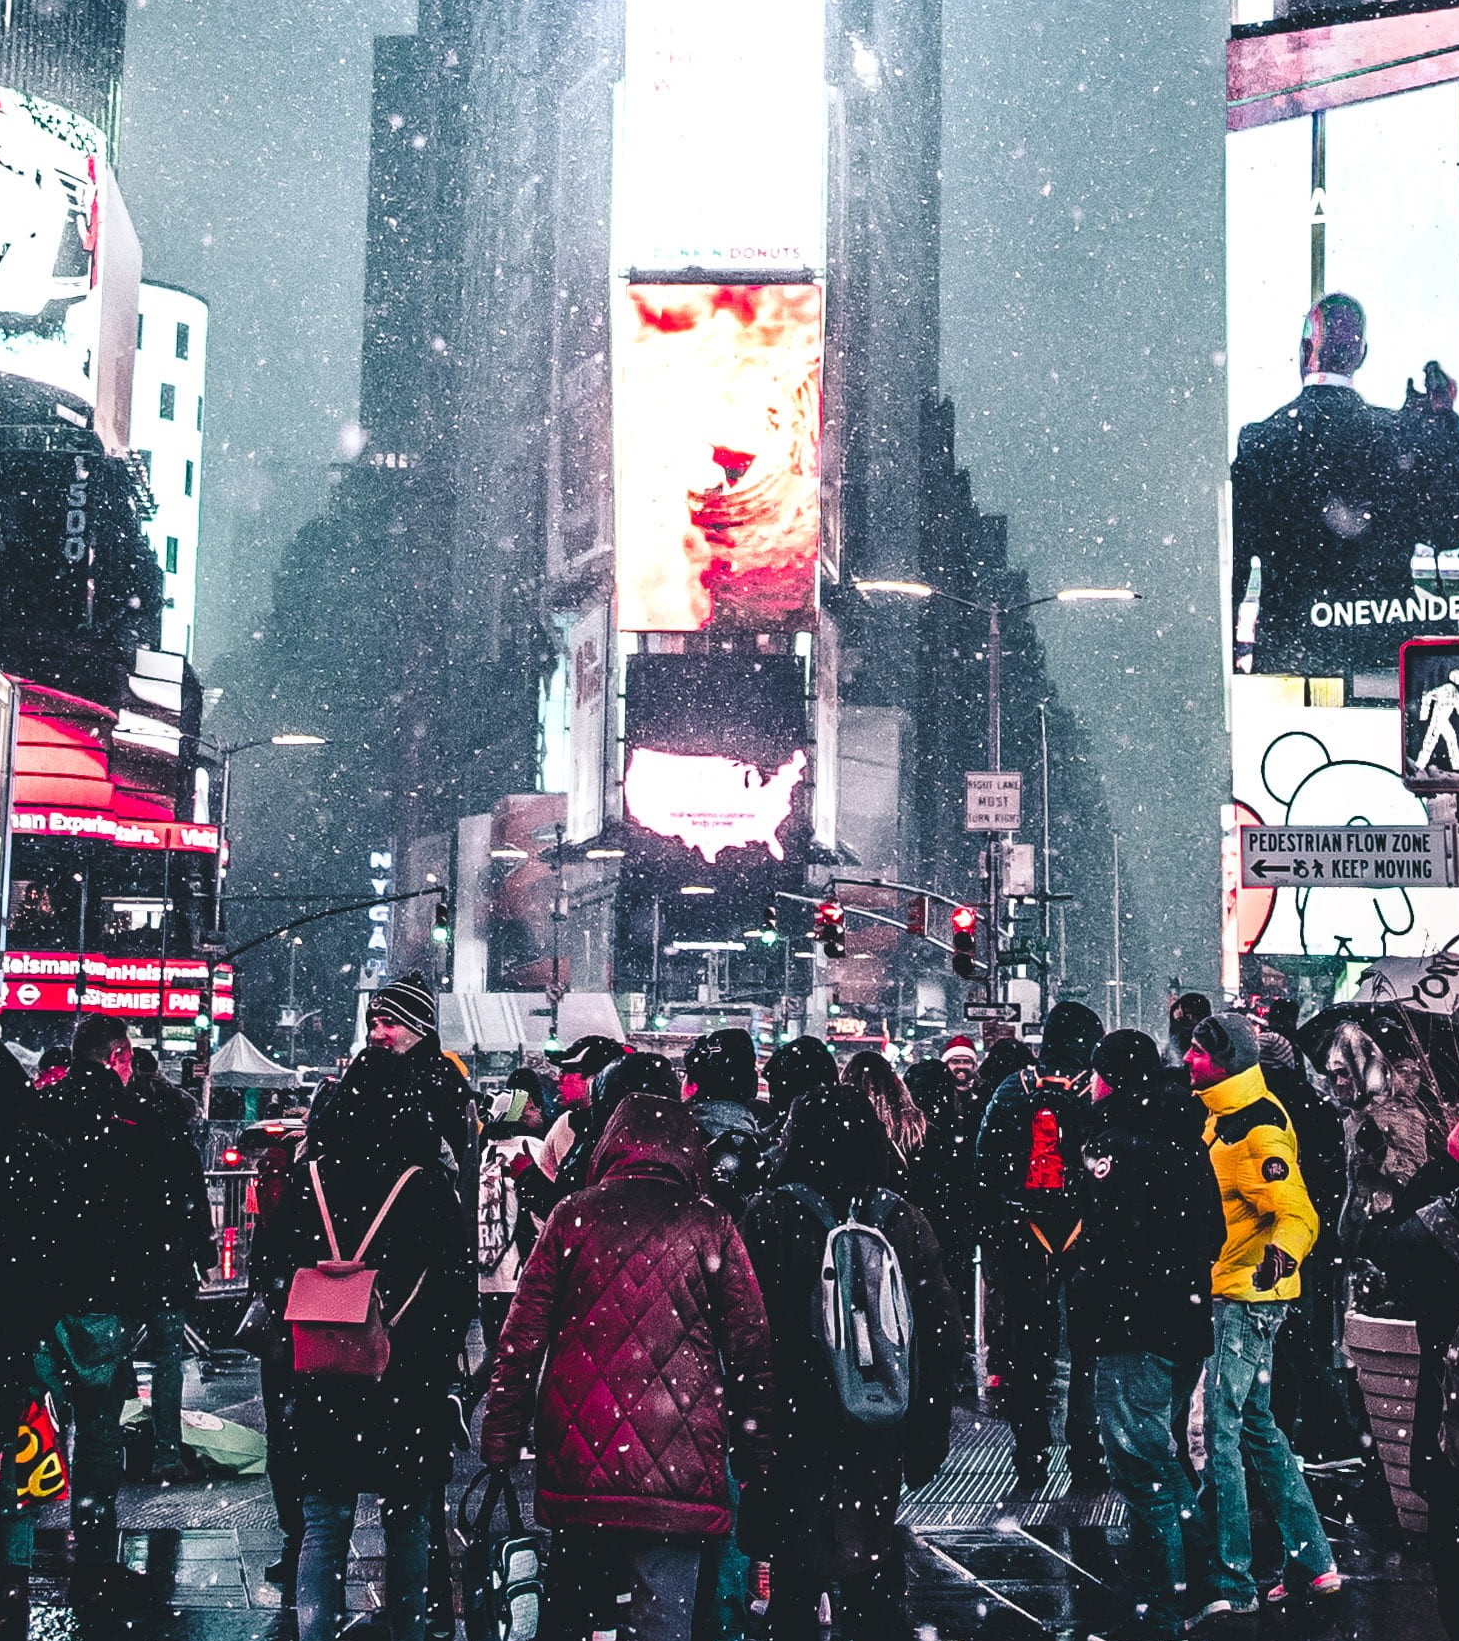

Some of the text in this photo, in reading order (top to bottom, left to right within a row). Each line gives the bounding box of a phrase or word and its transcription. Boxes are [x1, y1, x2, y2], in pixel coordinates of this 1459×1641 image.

[729, 247, 802, 260] DONUTS
[978, 796, 1009, 807] MUST
[1249, 833, 1431, 853] PEDESTRIAN FLOW ZONE
[1332, 859, 1432, 879] KEEP MOVING
